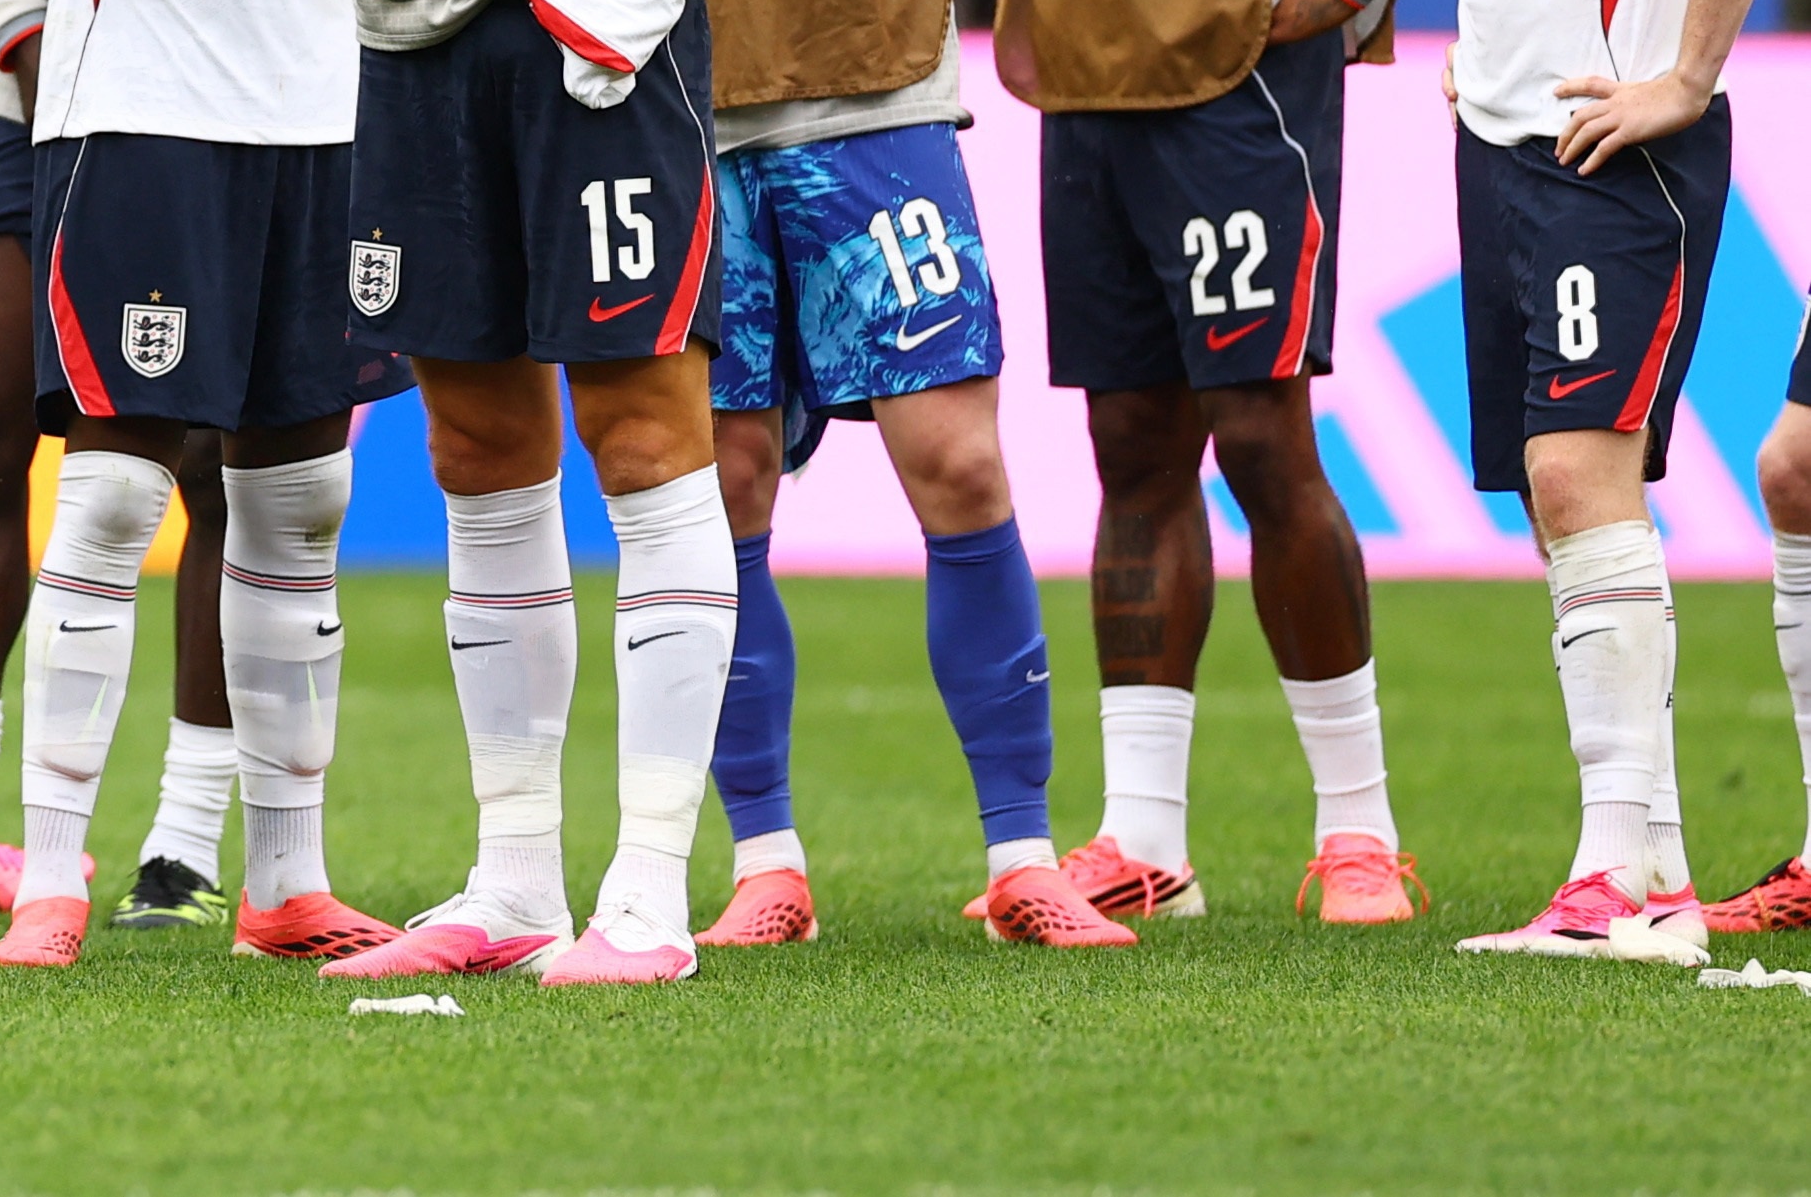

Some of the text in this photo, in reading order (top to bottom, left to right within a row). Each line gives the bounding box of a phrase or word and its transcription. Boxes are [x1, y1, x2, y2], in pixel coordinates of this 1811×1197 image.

[580, 176, 656, 283] 15
[868, 196, 963, 309] 13
[1182, 209, 1277, 317] 22
[1556, 264, 1599, 361] 8
